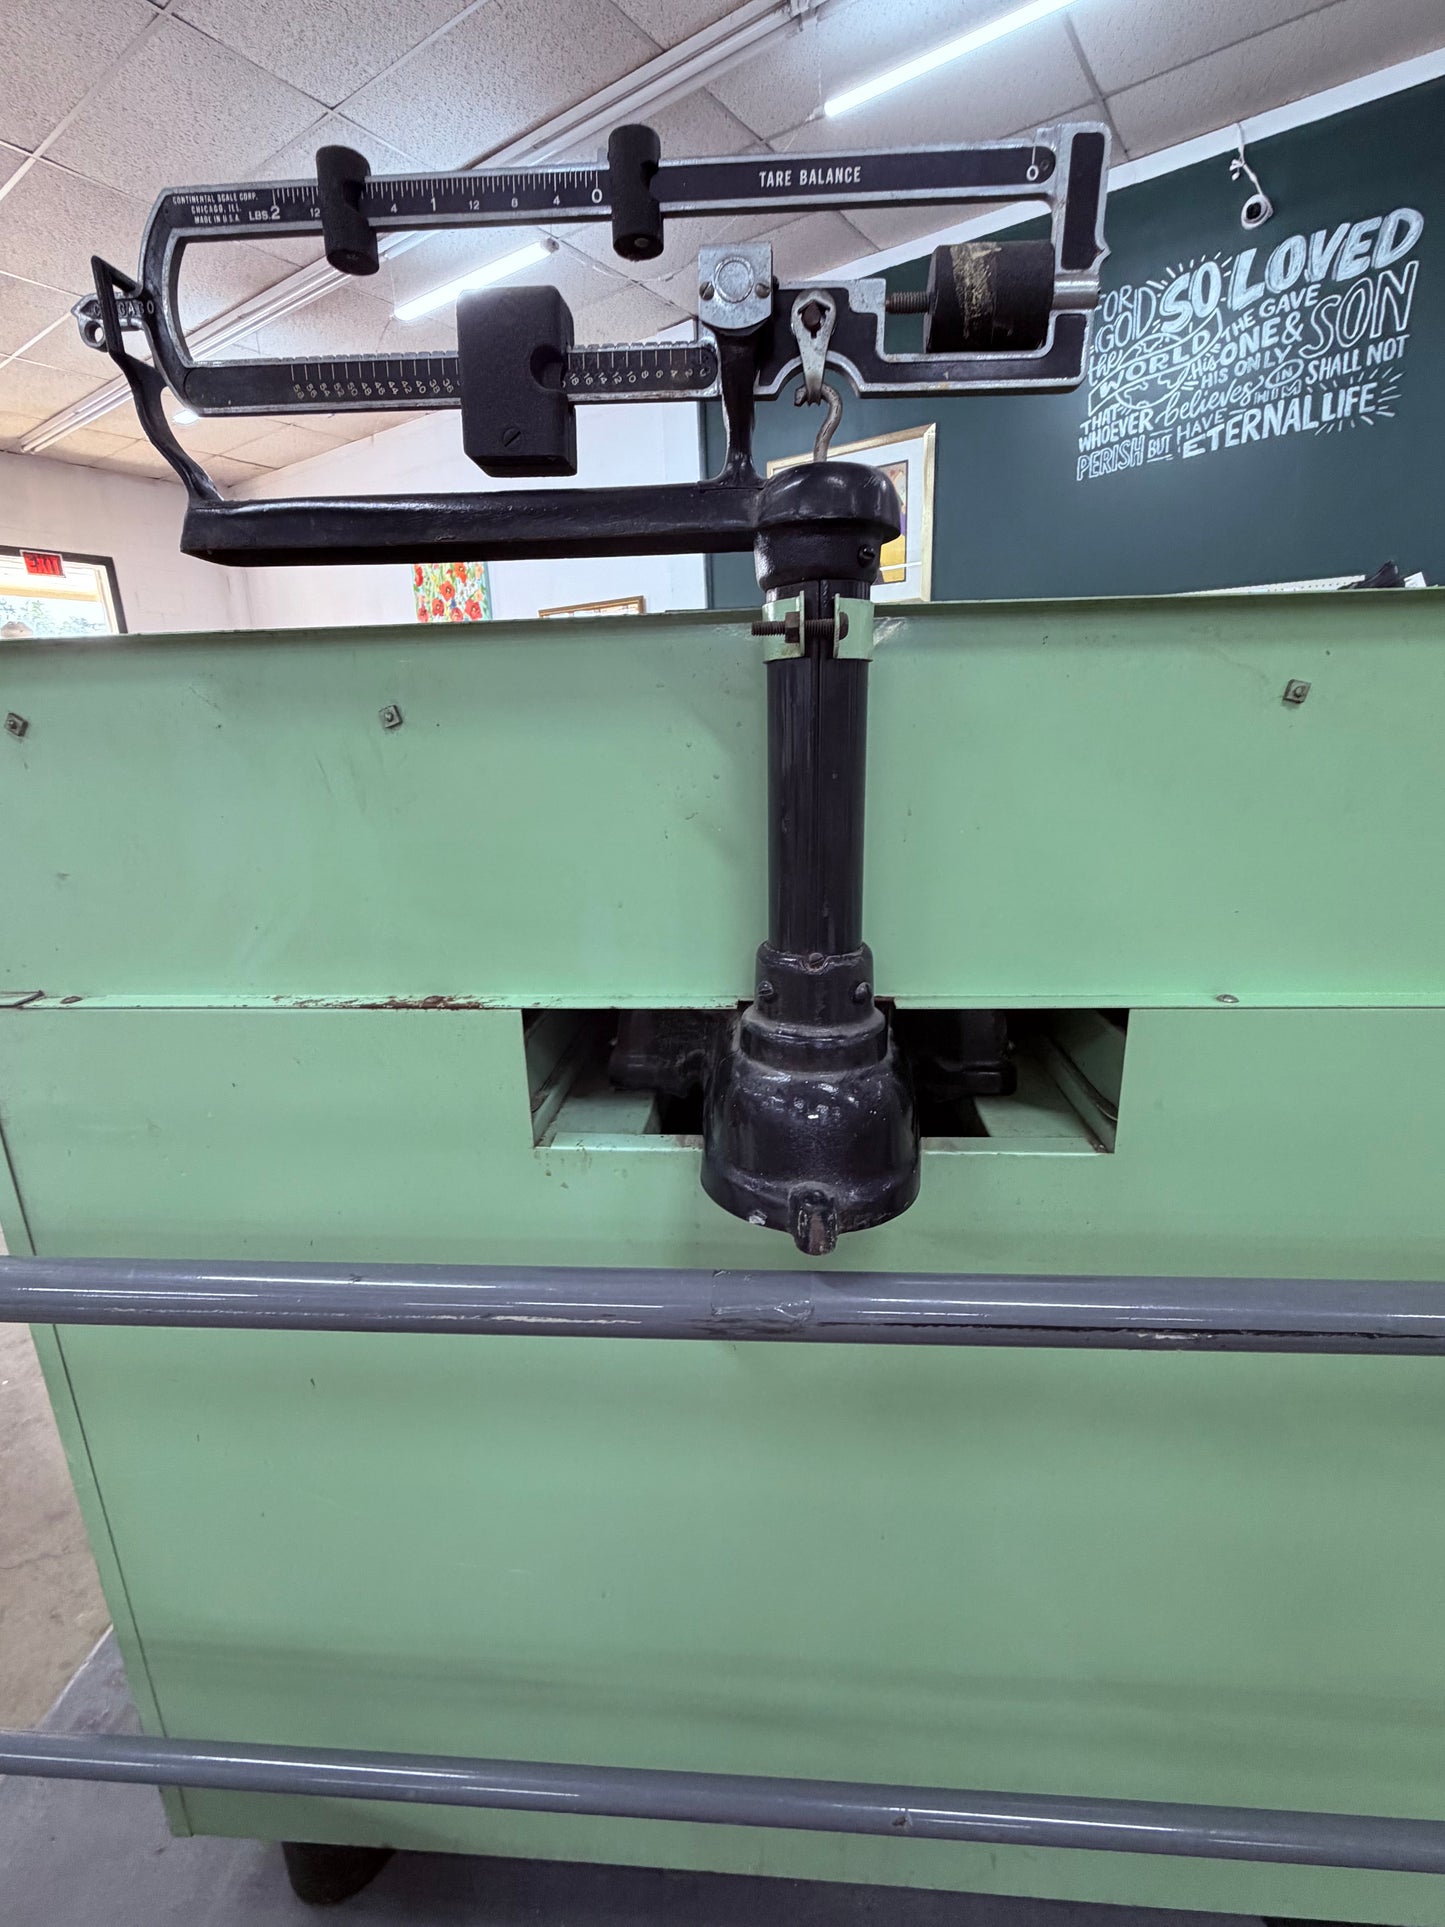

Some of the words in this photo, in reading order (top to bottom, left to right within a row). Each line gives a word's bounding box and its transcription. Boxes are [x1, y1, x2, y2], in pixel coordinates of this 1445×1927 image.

[759, 169, 792, 188] TARE
[799, 166, 862, 186] BALANCE
[172, 194, 215, 205] CONTINENTAL
[217, 192, 238, 203] SCALE
[239, 191, 259, 201] CORP.
[249, 209, 271, 222] LBS.
[271, 206, 280, 220] 2
[310, 207, 320, 217] 12
[390, 203, 398, 213] 4
[430, 197, 436, 212] 1
[469, 200, 480, 210] 12
[511, 197, 519, 208] 8
[553, 195, 560, 206] 4
[591, 188, 603, 203] 0
[194, 215, 212, 225] MADE
[213, 215, 220, 224] IN
[1095, 287, 1156, 353] GOD
[1160, 261, 1222, 333] SO
[1227, 208, 1424, 311] LOVED
[1095, 285, 1134, 322] OR
[1259, 284, 1321, 317] GAVE
[1201, 367, 1228, 389] HIS
[1234, 345, 1292, 377] ONLY
[1299, 260, 1419, 358] SON
[1220, 316, 1280, 366] ONE
[1281, 311, 1304, 344] &
[1088, 350, 1122, 387] the
[1100, 329, 1210, 398] WORLD
[1305, 348, 1361, 384] SHALL
[1366, 334, 1410, 366] NOT
[294, 384, 304, 399] 58
[306, 383, 317, 398] 56
[320, 382, 330, 397] 54
[334, 382, 345, 397] 52
[347, 382, 358, 396] 50
[361, 381, 372, 396] 48
[375, 381, 385, 395] 46
[388, 381, 399, 395] 44
[401, 380, 412, 394] 42
[415, 380, 426, 393] 40
[429, 379, 440, 393] 38
[443, 378, 454, 393] 36
[570, 373, 579, 386] 18
[584, 373, 593, 385] 16
[598, 372, 607, 384] 14
[612, 371, 622, 384] 12
[626, 371, 636, 383] 10
[670, 369, 678, 379] 4
[1079, 408, 1154, 453] WHOEVER
[1155, 375, 1264, 426] believes
[1276, 366, 1292, 384] IN
[1080, 402, 1121, 435] THAT
[1182, 395, 1320, 459] ETERNAL
[1321, 382, 1378, 422] LIFE
[1076, 435, 1145, 481] PERISH
[1147, 434, 1173, 459] BUT
[1177, 408, 1227, 446] HAVE
